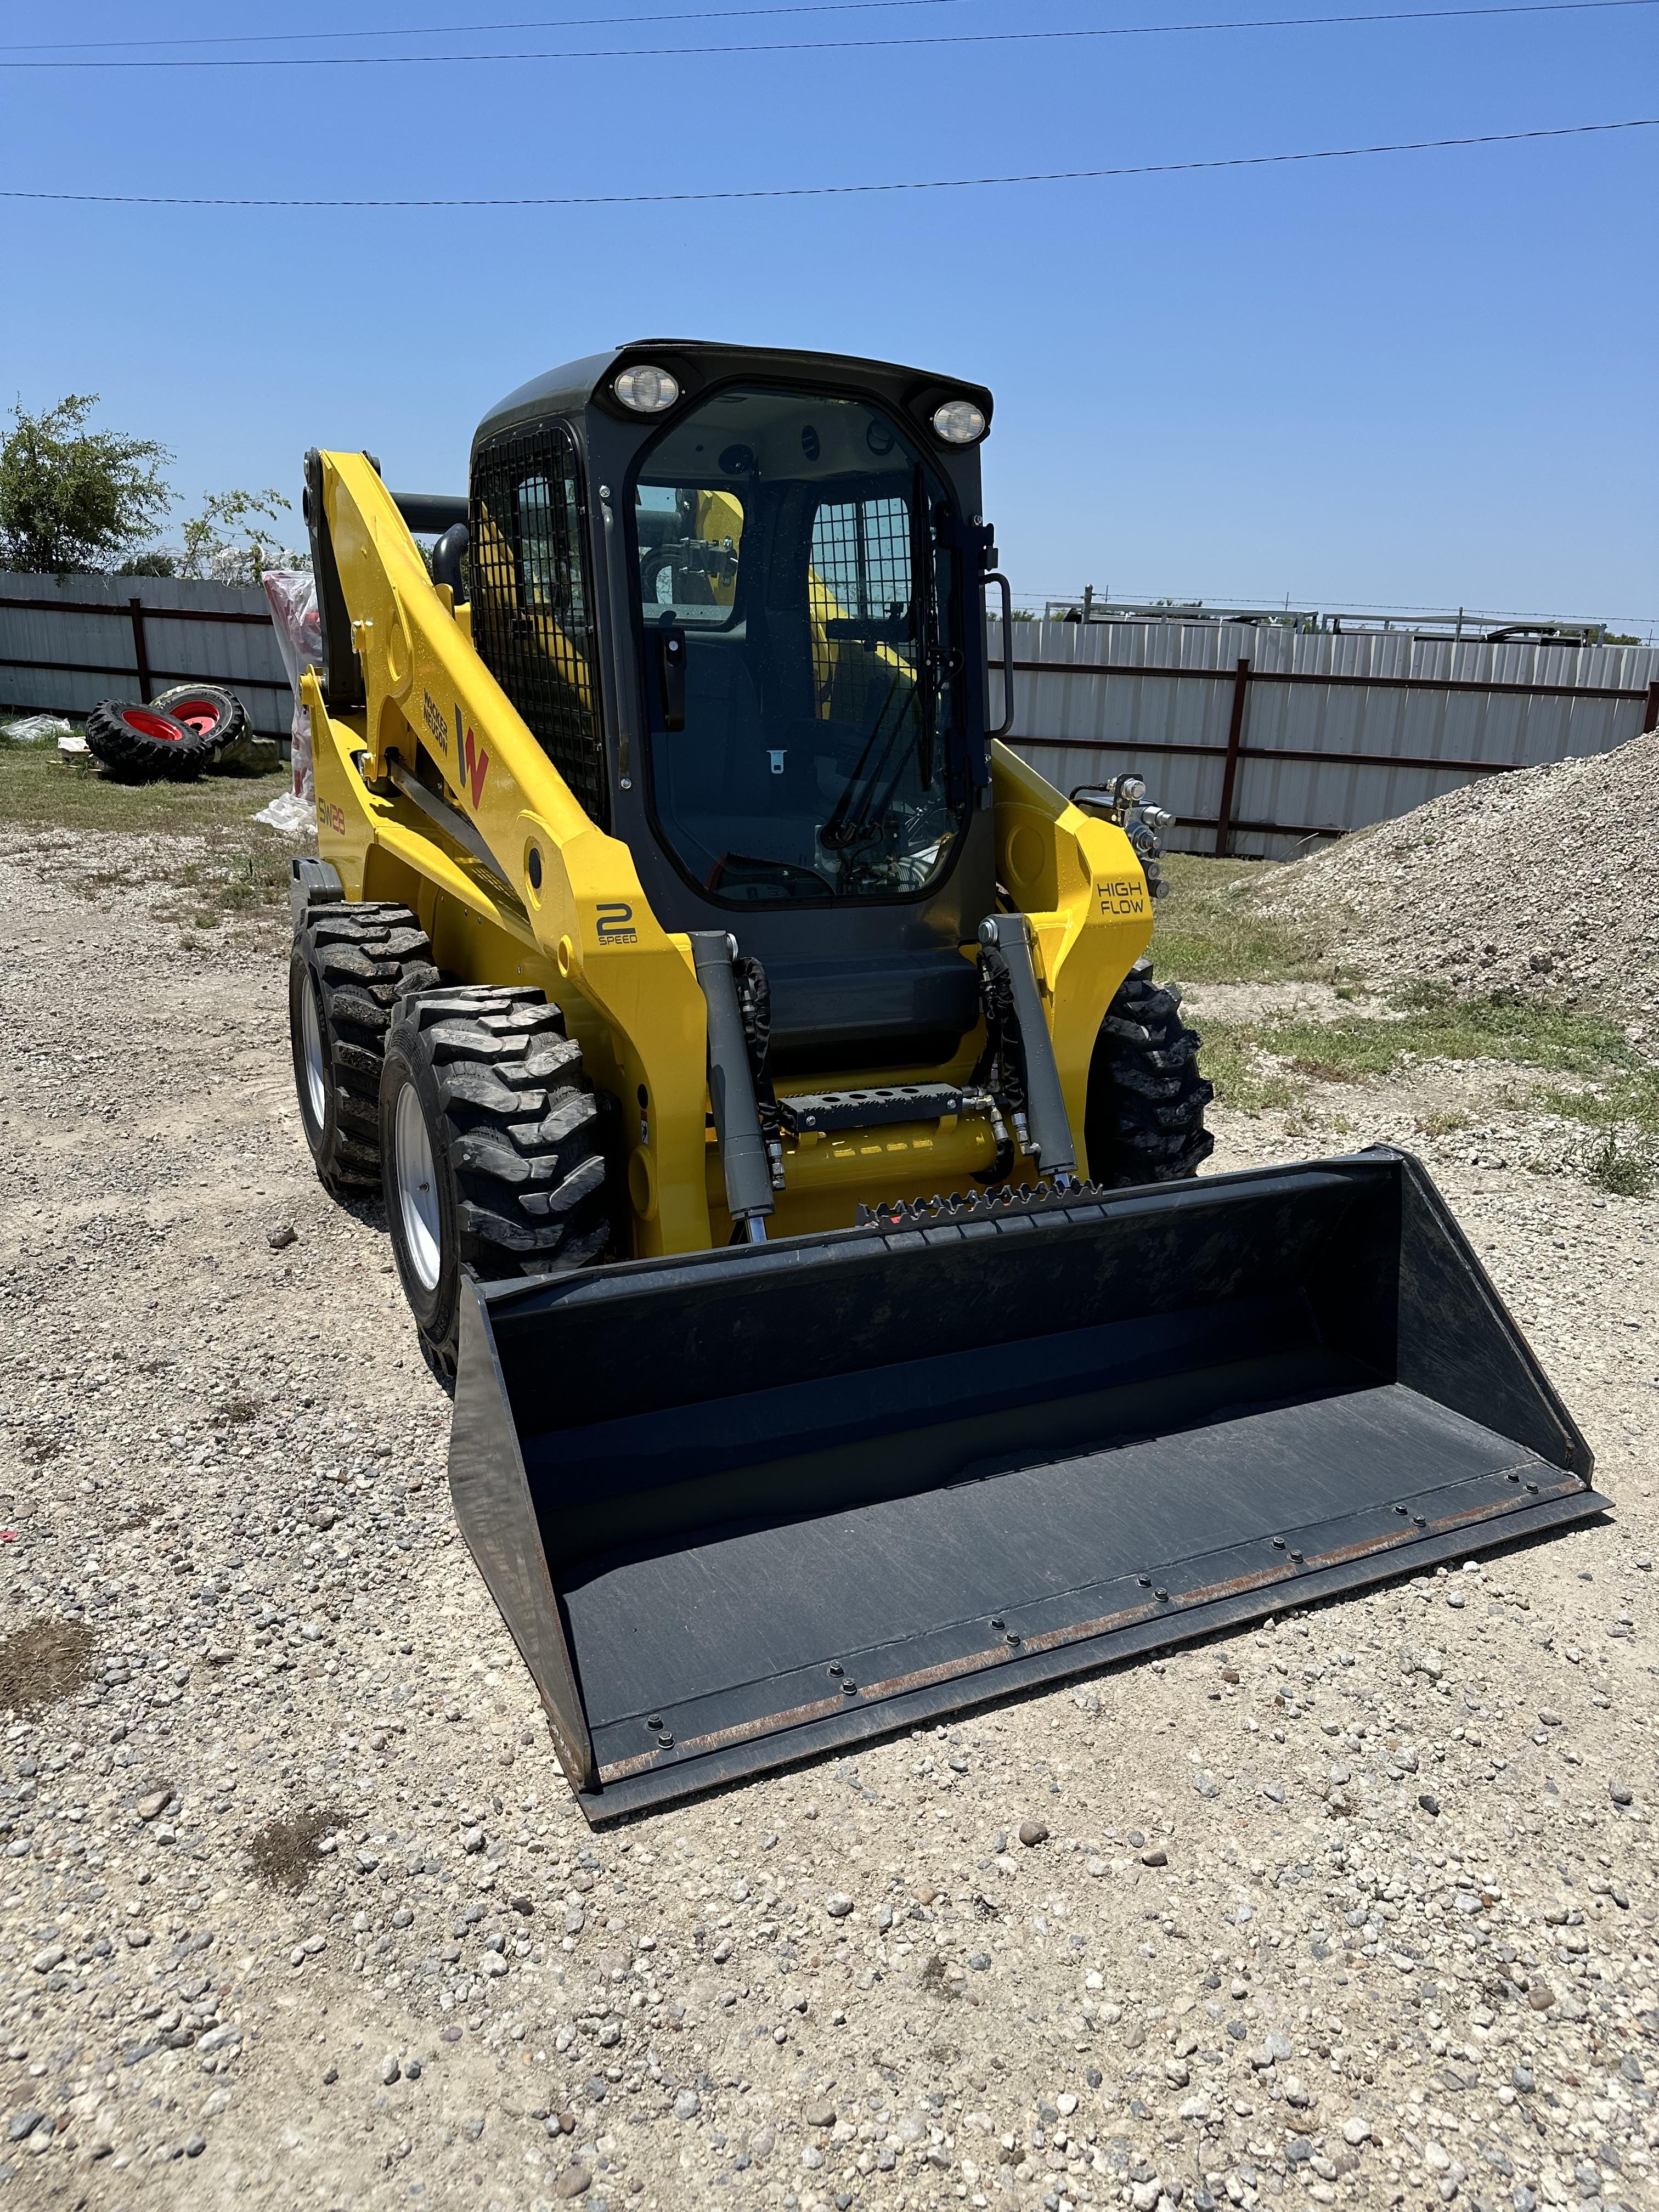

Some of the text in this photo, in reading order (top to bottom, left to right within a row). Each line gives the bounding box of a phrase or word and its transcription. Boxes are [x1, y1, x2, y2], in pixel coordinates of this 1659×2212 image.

[424, 687, 448, 738] WACKER
[424, 704, 448, 758] NEUSON
[319, 797, 345, 835] SW28
[1097, 882, 1142, 897] HIGH
[596, 903, 636, 936] 2
[1101, 899, 1143, 915] FLOW
[599, 935, 637, 945] SPEED
